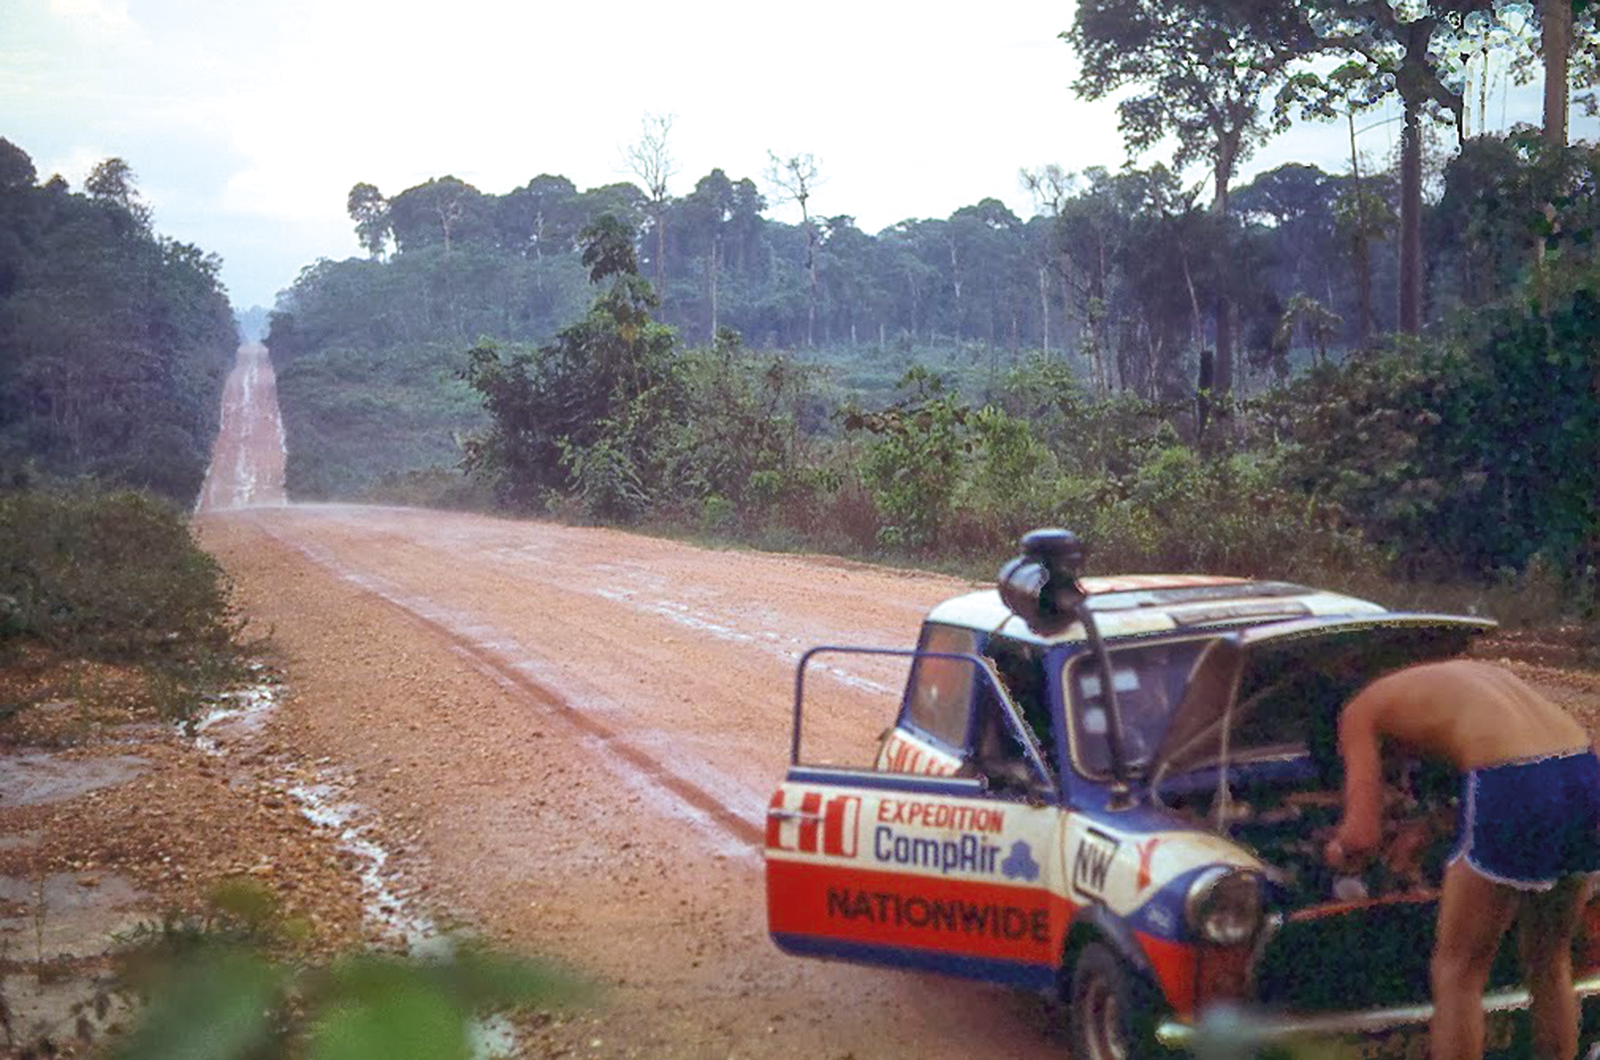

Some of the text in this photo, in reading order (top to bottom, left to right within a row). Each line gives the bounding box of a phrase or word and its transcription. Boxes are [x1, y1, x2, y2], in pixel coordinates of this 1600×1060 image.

[877, 798, 1005, 834] EXPEDITION
[874, 826, 1002, 874] CompAir
[826, 886, 1050, 942] NATIONWIDE
